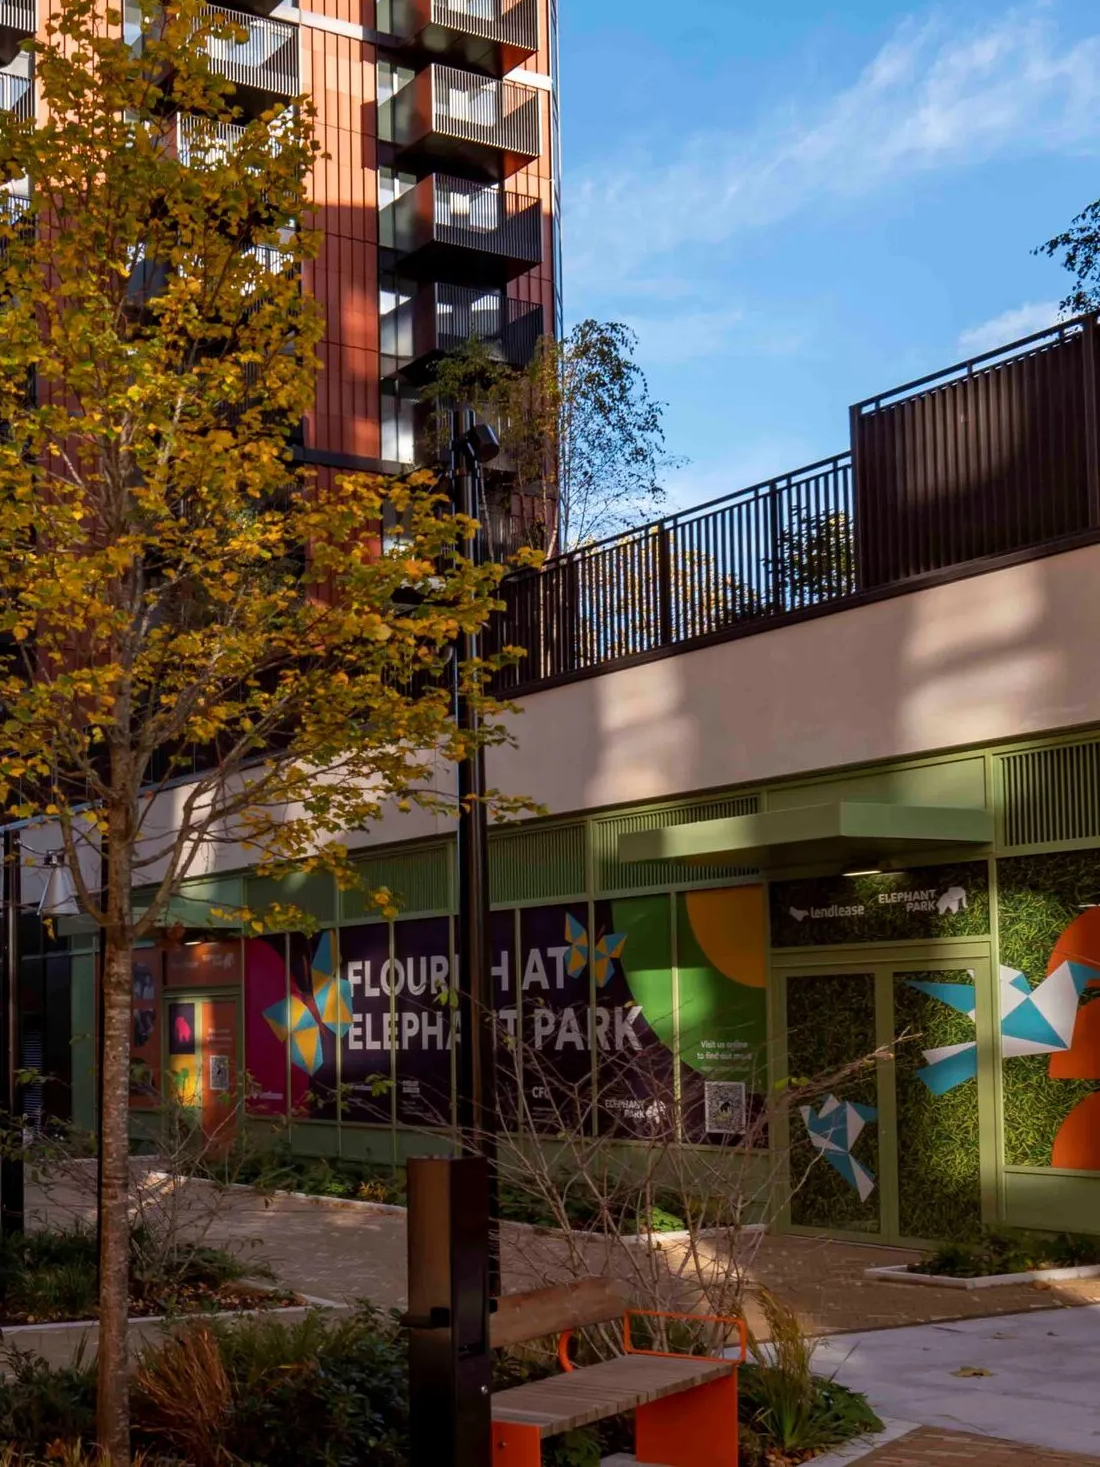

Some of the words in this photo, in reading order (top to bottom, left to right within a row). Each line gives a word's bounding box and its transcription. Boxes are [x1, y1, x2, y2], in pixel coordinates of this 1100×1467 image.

[878, 889, 937, 904] ELEPHANT
[810, 904, 865, 919] lendlease
[906, 900, 937, 913] PARK
[347, 950, 509, 997] FLOURIH
[522, 946, 569, 990] AT
[348, 1008, 517, 1050] ELEPHT
[534, 1005, 643, 1051] PARK
[700, 1040, 716, 1049] Visit
[717, 1041, 726, 1049] us
